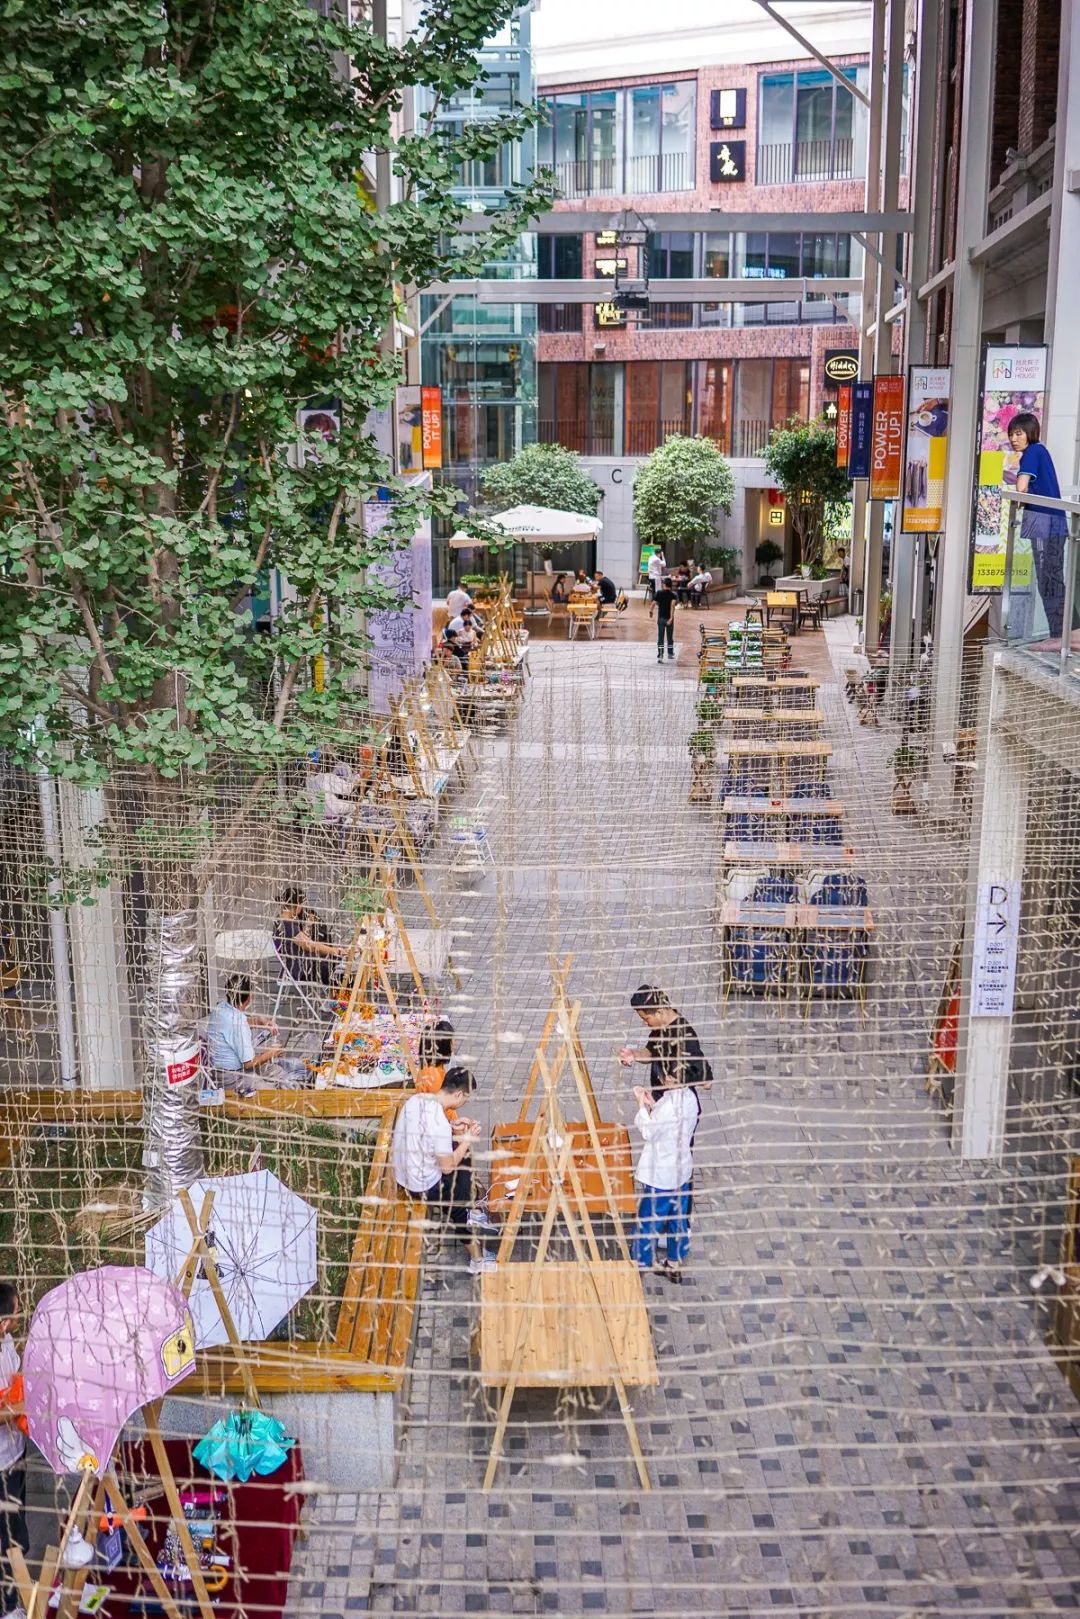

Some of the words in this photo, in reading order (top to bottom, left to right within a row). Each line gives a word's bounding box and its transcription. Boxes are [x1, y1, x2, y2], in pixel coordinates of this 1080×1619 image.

[830, 361, 856, 372] Hidden
[432, 409, 440, 427] UP!
[889, 411, 902, 436] UP!
[423, 410, 431, 449] POWER
[432, 430, 440, 440] IT
[839, 409, 848, 449] POWER
[874, 411, 888, 470] POWER
[889, 442, 900, 455] IT
[611, 469, 623, 484] C
[990, 886, 1008, 905] D
